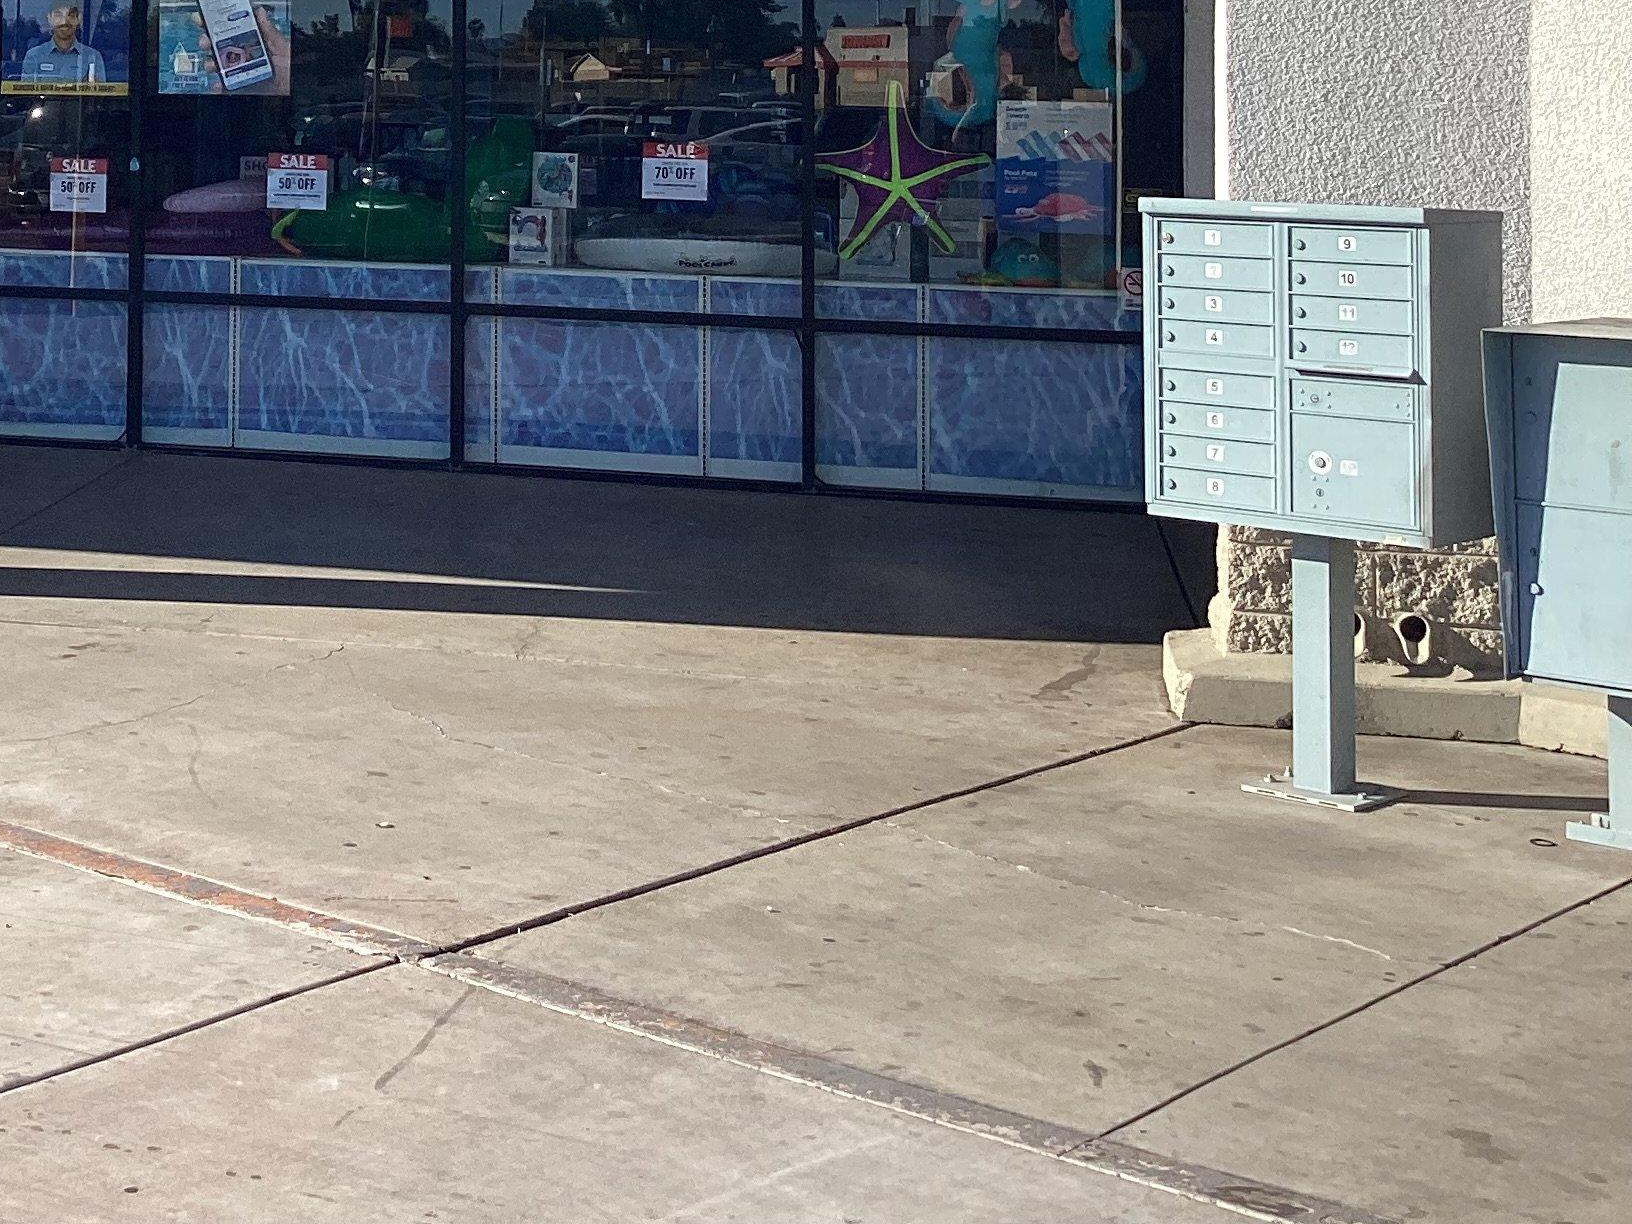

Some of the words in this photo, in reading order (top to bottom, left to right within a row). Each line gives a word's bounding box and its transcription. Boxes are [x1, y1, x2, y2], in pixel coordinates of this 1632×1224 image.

[655, 142, 696, 159] SALE
[62, 158, 97, 173] SALE
[279, 154, 317, 169] SALE
[675, 166, 696, 180] OFF
[78, 181, 97, 194] OFF
[297, 177, 317, 190] OFF
[1343, 238, 1351, 250] 9
[1341, 273, 1355, 284] 10
